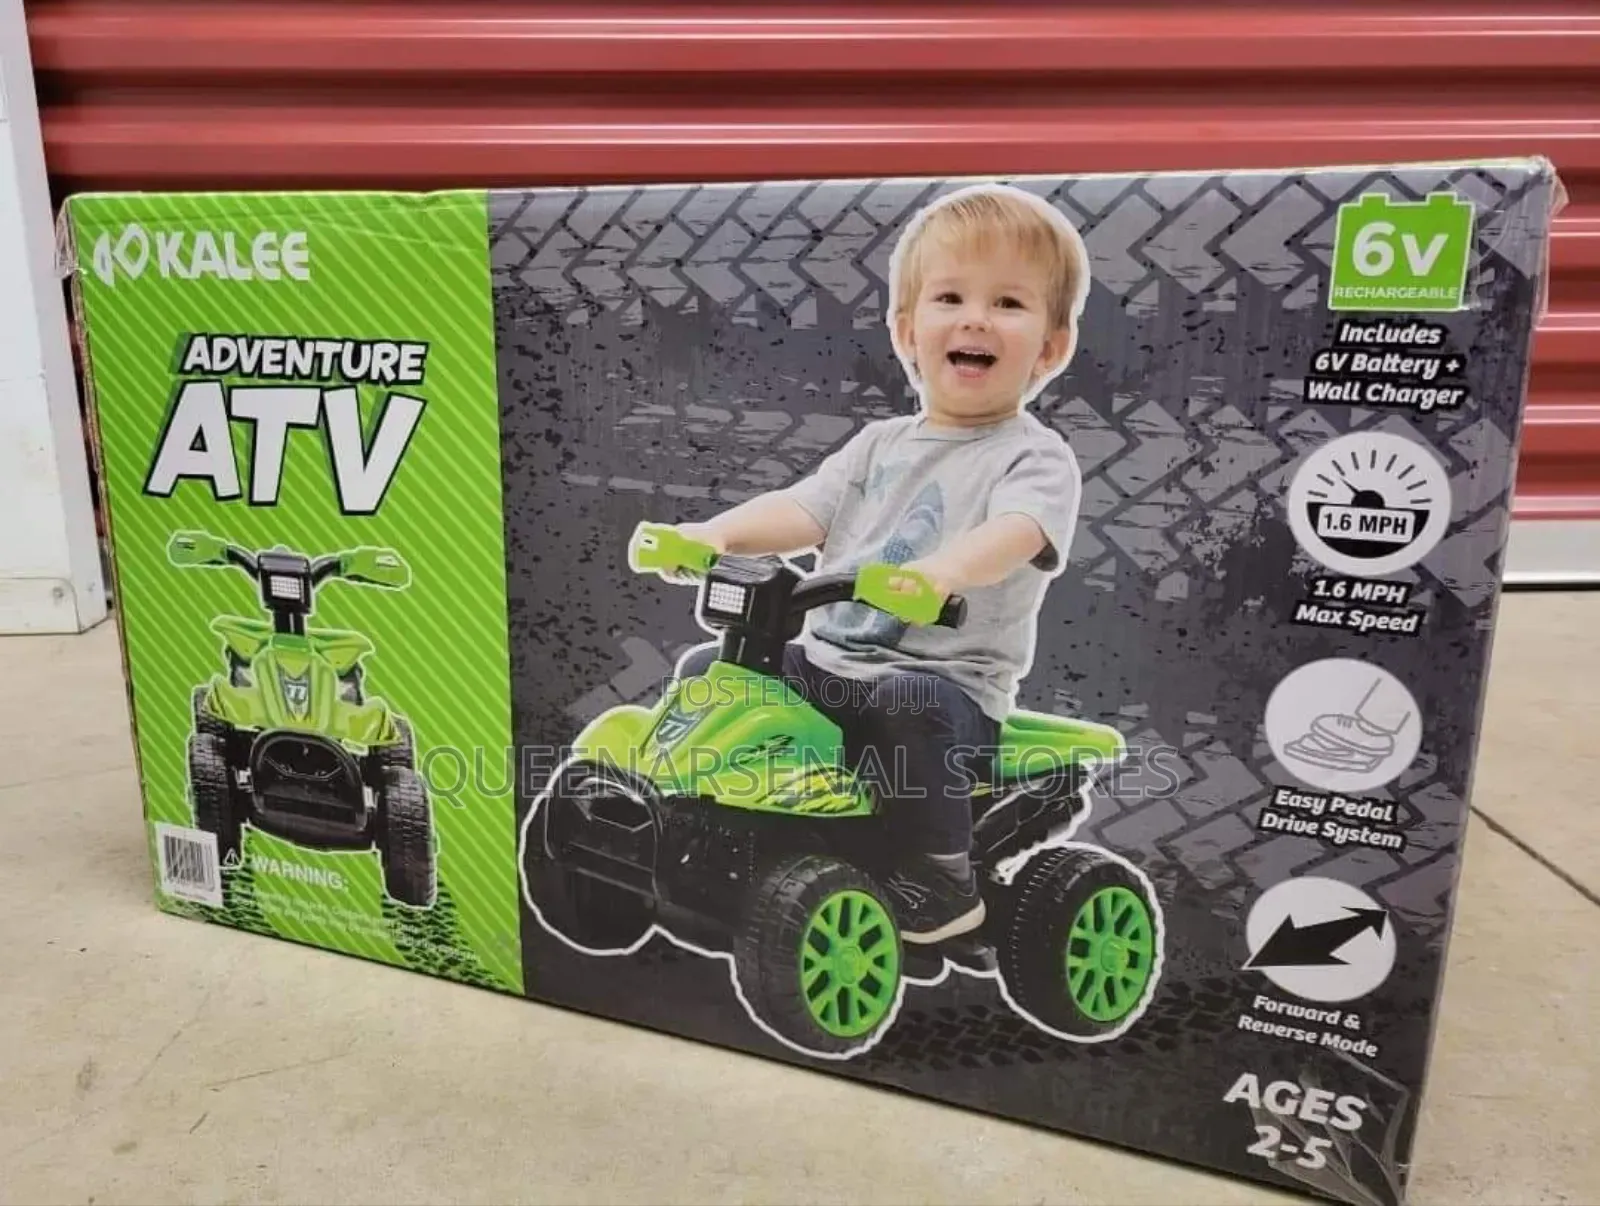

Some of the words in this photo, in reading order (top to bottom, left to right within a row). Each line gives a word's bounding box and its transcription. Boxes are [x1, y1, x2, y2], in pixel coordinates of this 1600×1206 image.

[1335, 286, 1458, 300] RECHARGEABLE
[1339, 323, 1442, 345] Includes
[181, 334, 428, 384] ADVENTURE
[1315, 353, 1349, 372] 6V
[1350, 353, 1441, 381] Battery
[1445, 360, 1461, 374] +
[1307, 380, 1362, 401] Wall
[1366, 383, 1464, 410] Charger
[143, 379, 428, 516] ATV
[1323, 512, 1353, 532] 1.6
[1358, 514, 1408, 536] MPH
[1313, 579, 1347, 598] 1.6
[1349, 583, 1407, 605] MPH
[1295, 603, 1345, 625] Max
[1346, 609, 1420, 633] Speed
[1275, 789, 1327, 815] Easy
[1329, 796, 1394, 822] Pedal
[1261, 812, 1320, 836] Drive
[1321, 820, 1403, 849] System
[250, 855, 350, 893] WARNING:
[1253, 994, 1342, 1026] Forward
[1343, 1013, 1361, 1031] &
[1237, 1014, 1318, 1045] Reverse
[1319, 1031, 1379, 1058] Mode
[1222, 1071, 1368, 1132] AGES
[1246, 1124, 1334, 1170] 2-5
